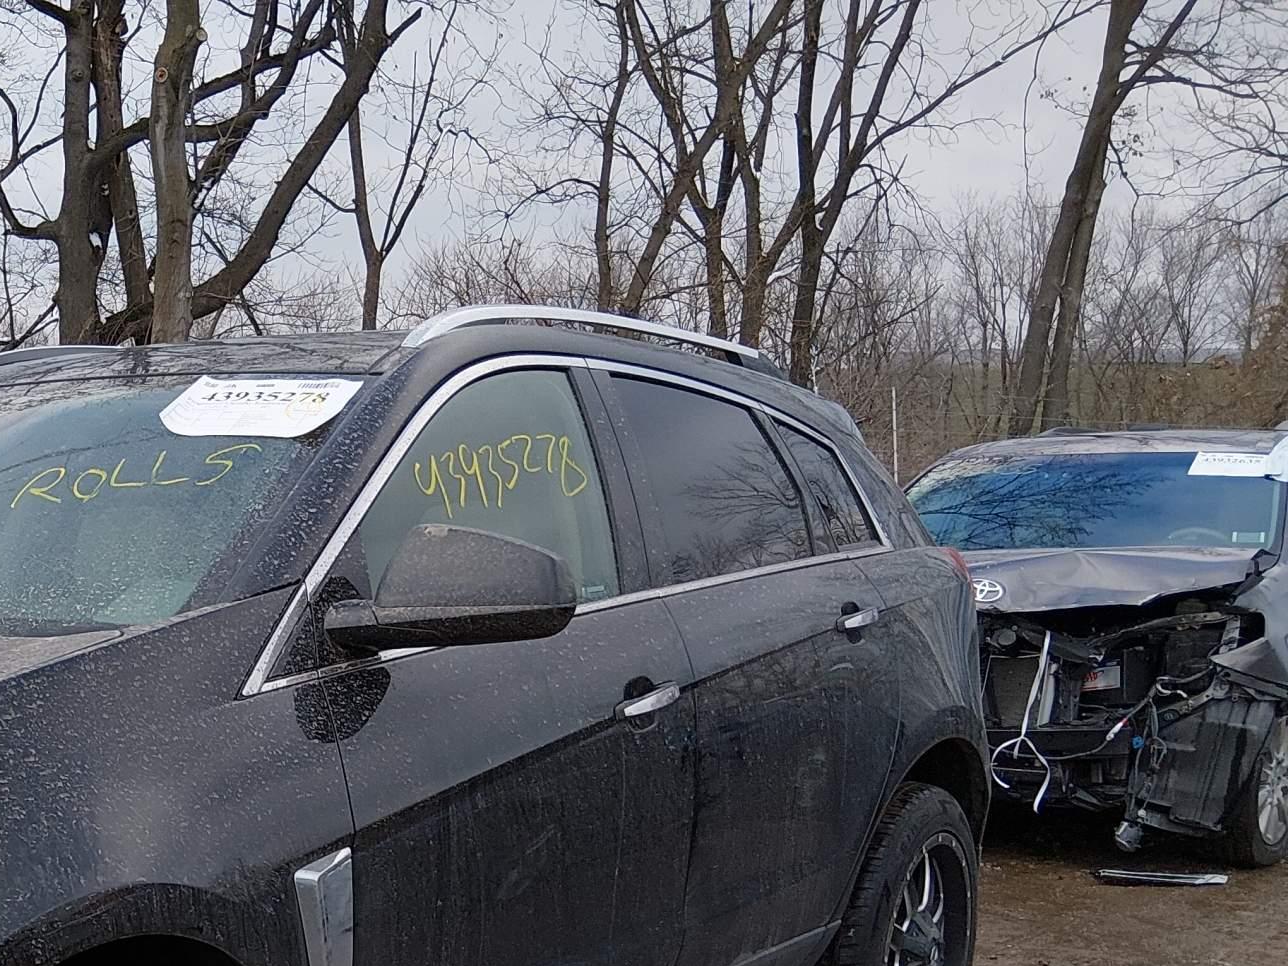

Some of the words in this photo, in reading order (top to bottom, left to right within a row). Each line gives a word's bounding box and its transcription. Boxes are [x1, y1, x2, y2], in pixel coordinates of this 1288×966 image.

[202, 391, 330, 402] 43935278
[10, 443, 262, 508] ROLLS
[414, 434, 588, 519] 43935278
